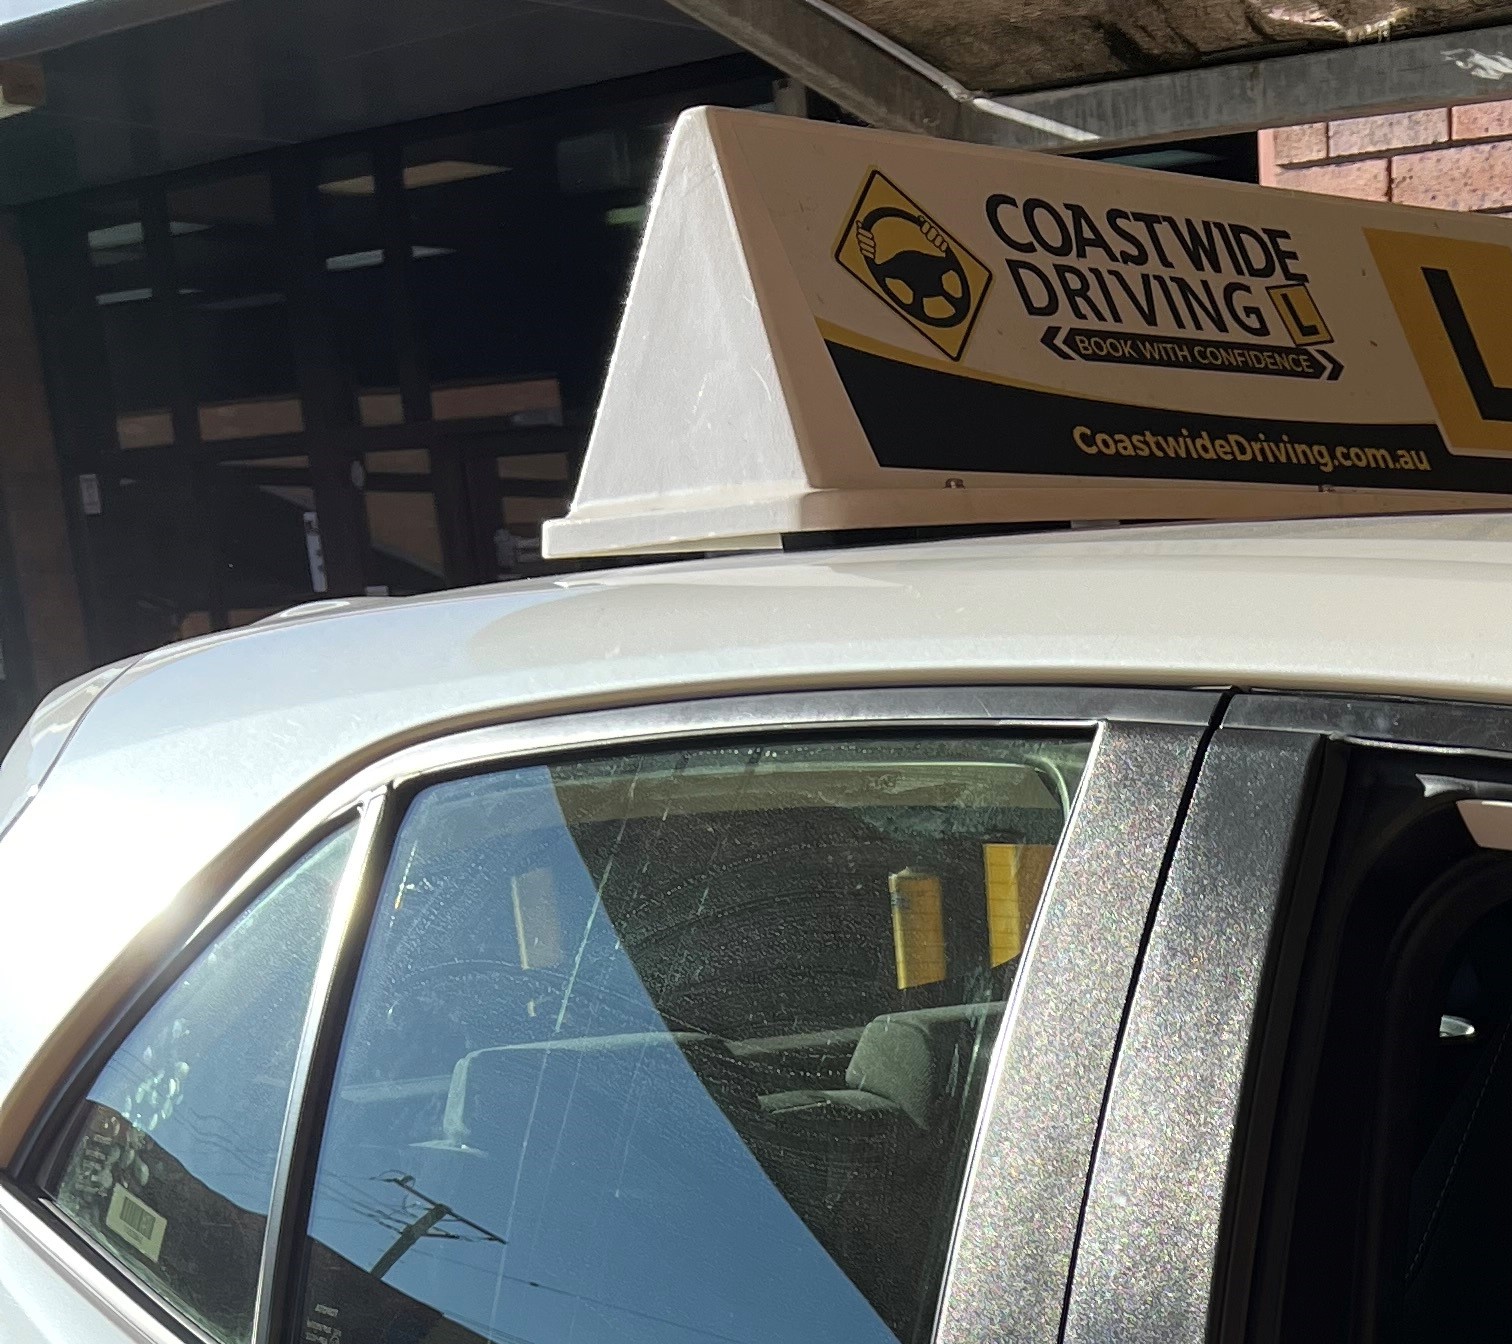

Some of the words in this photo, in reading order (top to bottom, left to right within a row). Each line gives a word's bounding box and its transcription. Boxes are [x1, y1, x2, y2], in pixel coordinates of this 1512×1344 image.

[985, 193, 1309, 283] COASTWIDE
[1005, 258, 1271, 338] DRIVING
[1280, 292, 1320, 338] L
[1075, 335, 1142, 359] BOOK
[1138, 341, 1193, 363] WITH
[1195, 345, 1314, 374] CONFIDENCE
[1072, 425, 1432, 473] CoastwideDriving.com.au
